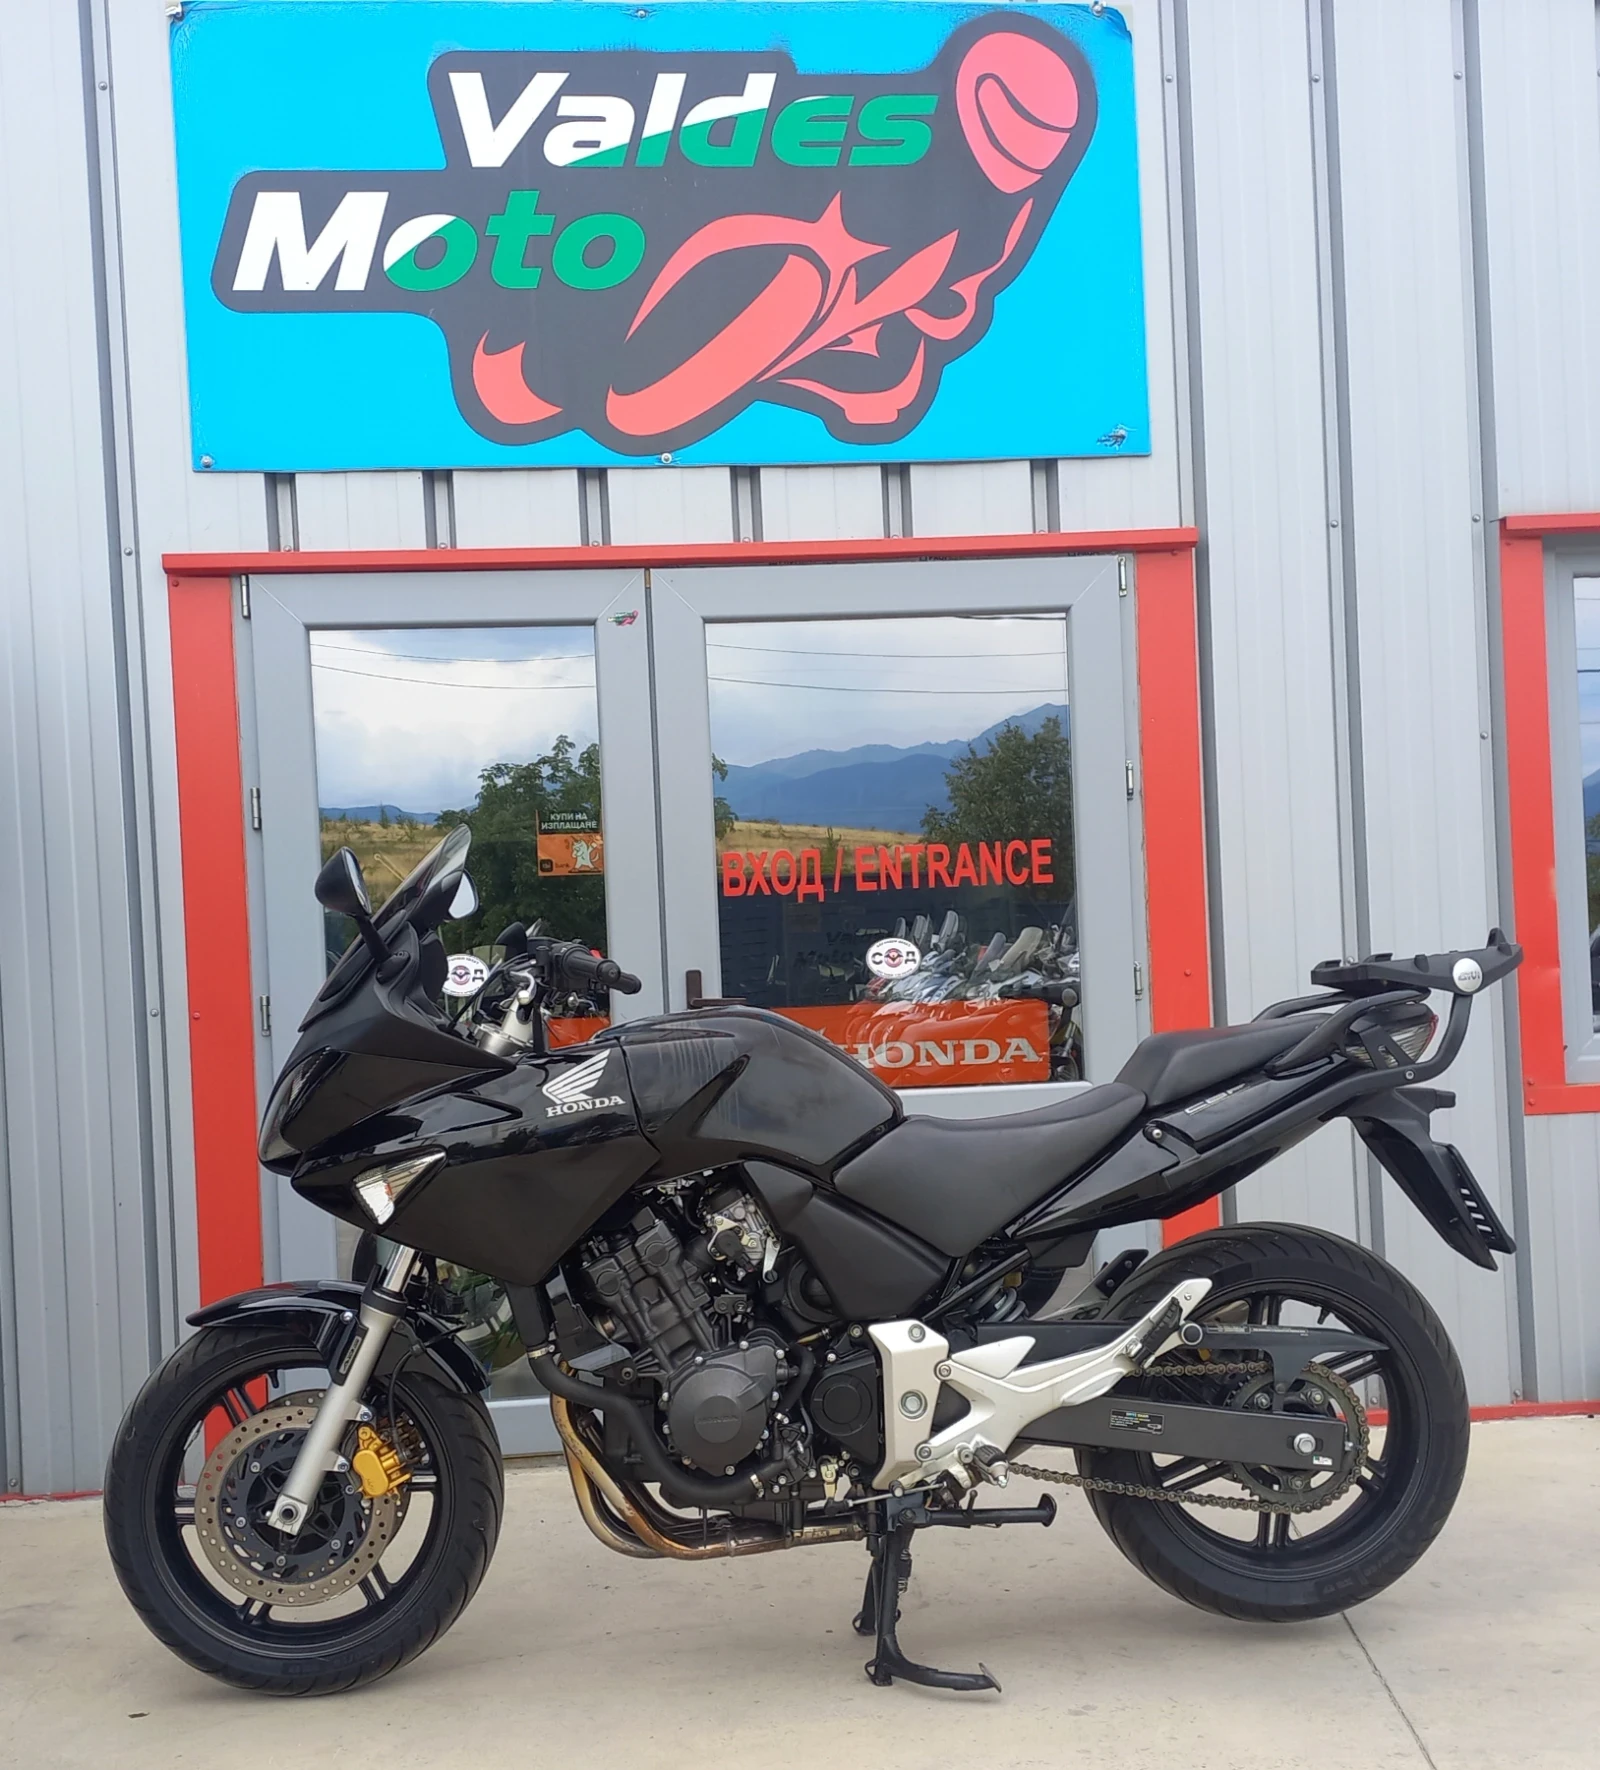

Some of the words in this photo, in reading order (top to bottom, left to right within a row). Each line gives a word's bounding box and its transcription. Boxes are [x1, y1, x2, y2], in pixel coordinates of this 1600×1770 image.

[448, 72, 938, 167] Valdes
[232, 190, 646, 291] Moto
[541, 821, 598, 829] ИЗПЛАЩАНЕ
[550, 813, 574, 821] КУПИ
[575, 812, 588, 820] НА
[722, 848, 824, 903] ВХОД
[834, 850, 843, 893] /
[855, 839, 1054, 892] ENTRANCE
[545, 1095, 626, 1118] HONDA
